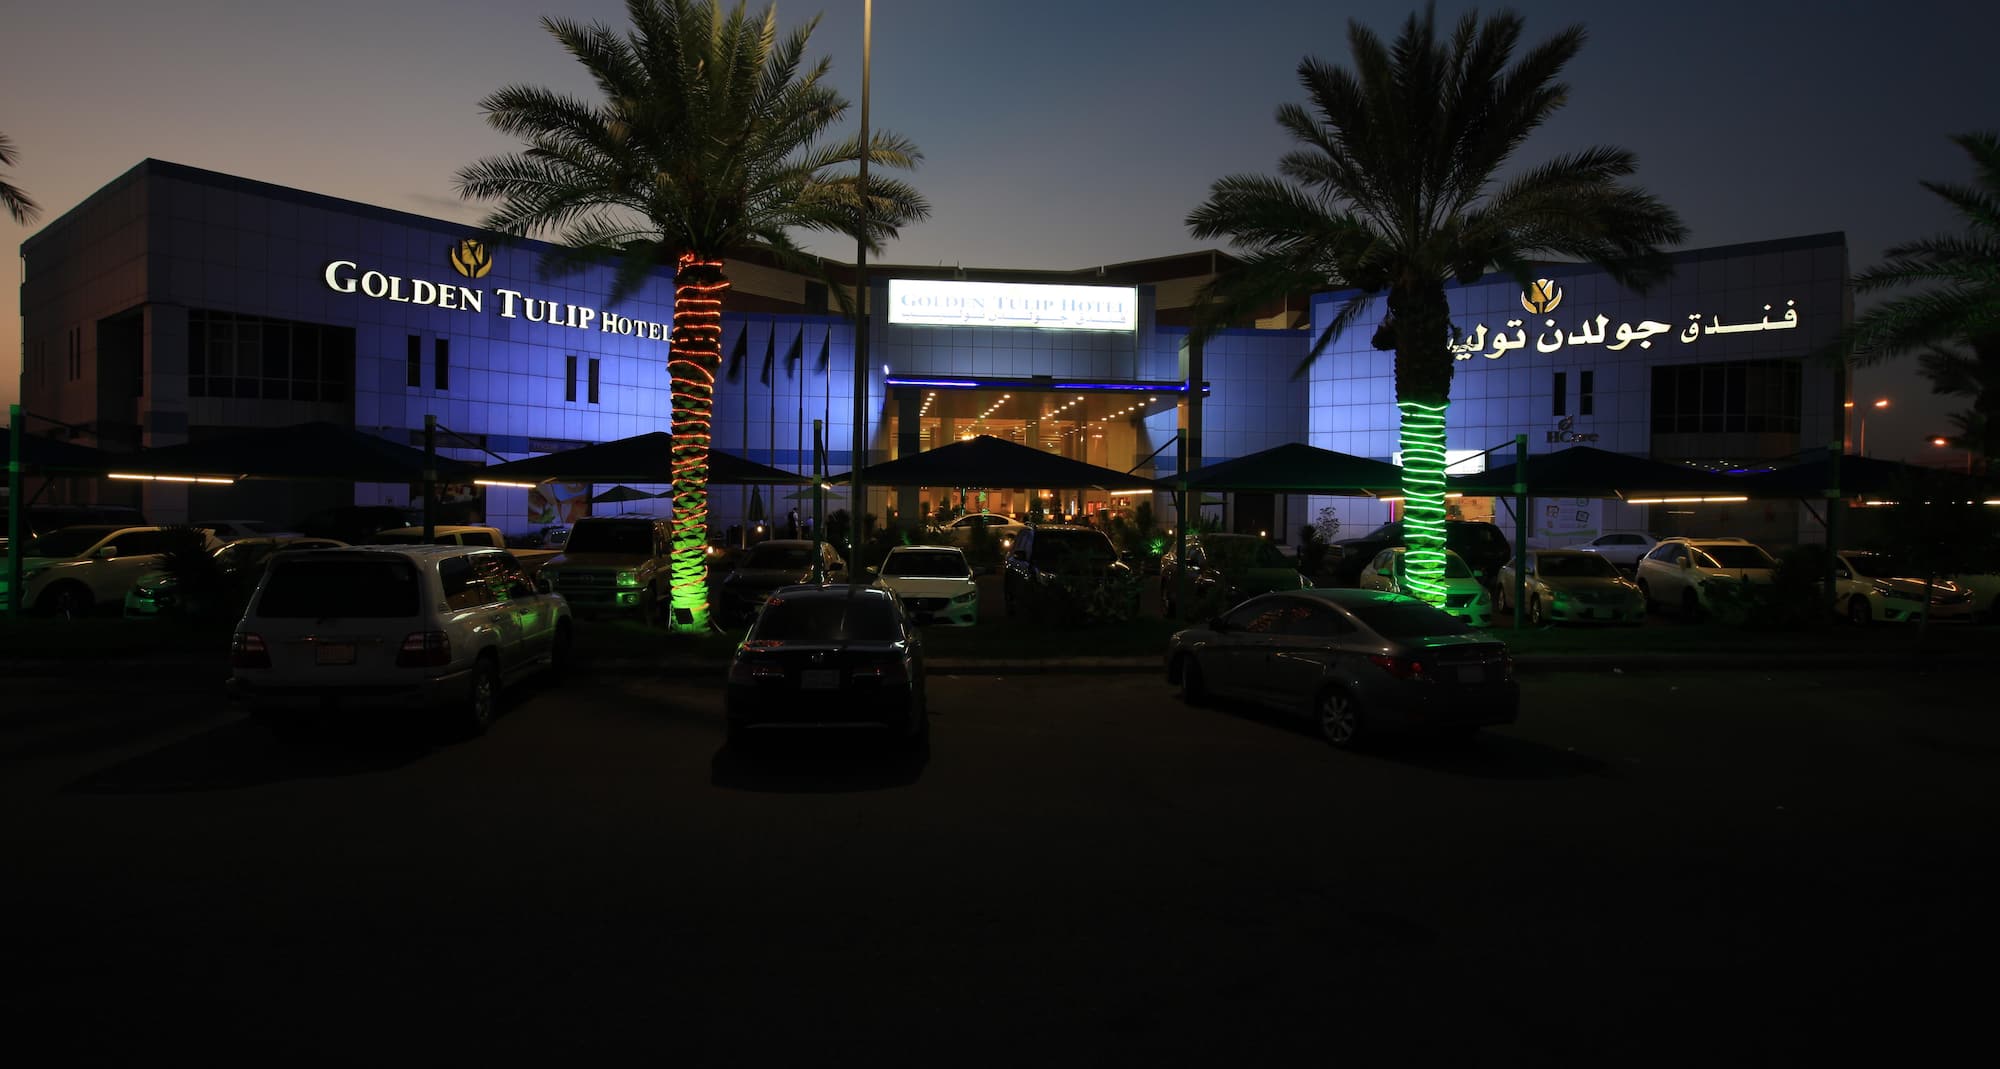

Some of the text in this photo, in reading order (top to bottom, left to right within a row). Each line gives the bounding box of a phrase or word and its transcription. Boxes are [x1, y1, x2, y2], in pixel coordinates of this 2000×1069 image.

[325, 260, 673, 342] GOLDEN TULIP HOTEL
[900, 294, 985, 308] GOLDEN
[993, 296, 1054, 312] TULIP
[1680, 299, 1798, 344] فندق
[1536, 313, 1672, 353] جولدن
